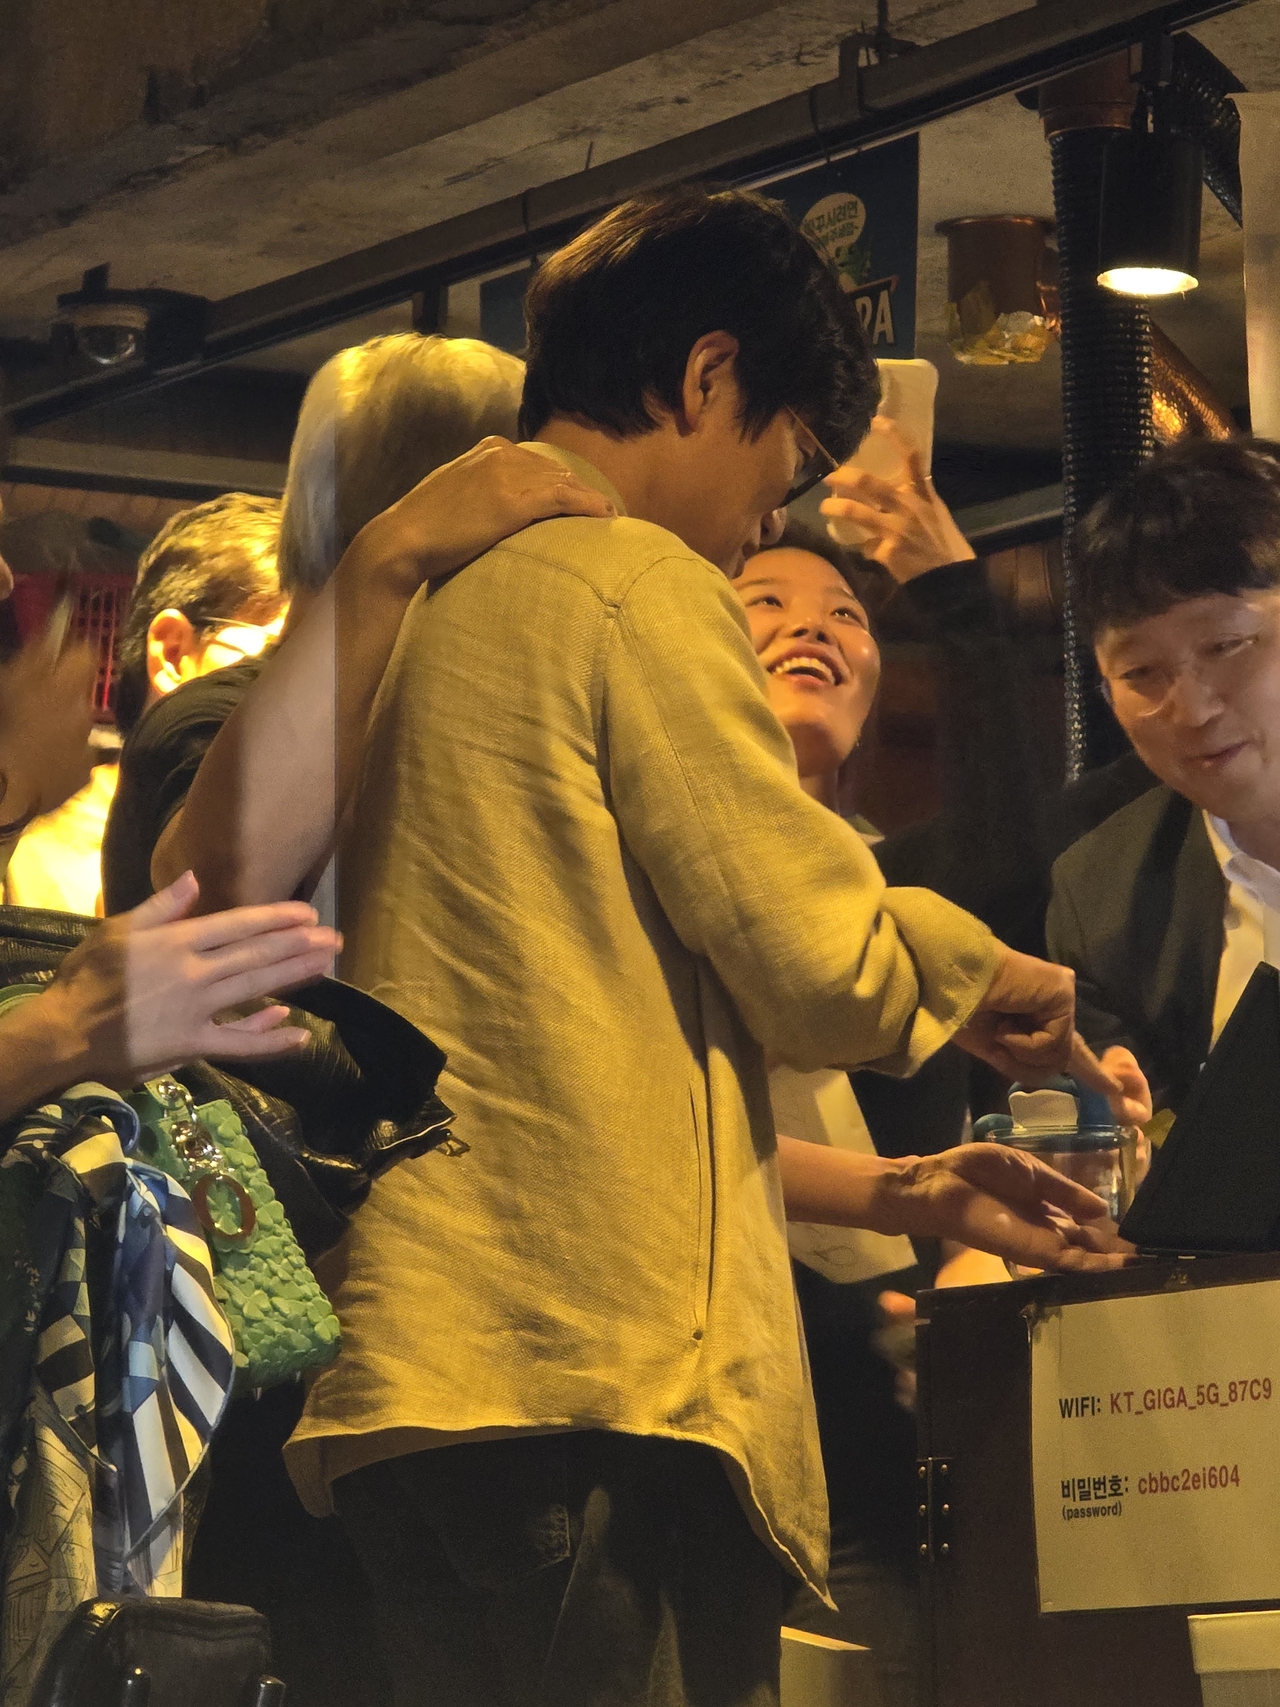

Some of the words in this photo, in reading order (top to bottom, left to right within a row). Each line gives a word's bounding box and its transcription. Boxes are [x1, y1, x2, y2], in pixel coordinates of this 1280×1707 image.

[1058, 1396, 1101, 1419] WIFI:
[1110, 1377, 1272, 1415] KT_GIGA_5G_87C9
[1061, 1475, 1129, 1502] 비밀번호:
[1138, 1464, 1240, 1495] cbbc2ei604
[1062, 1502, 1122, 1521] (password)
